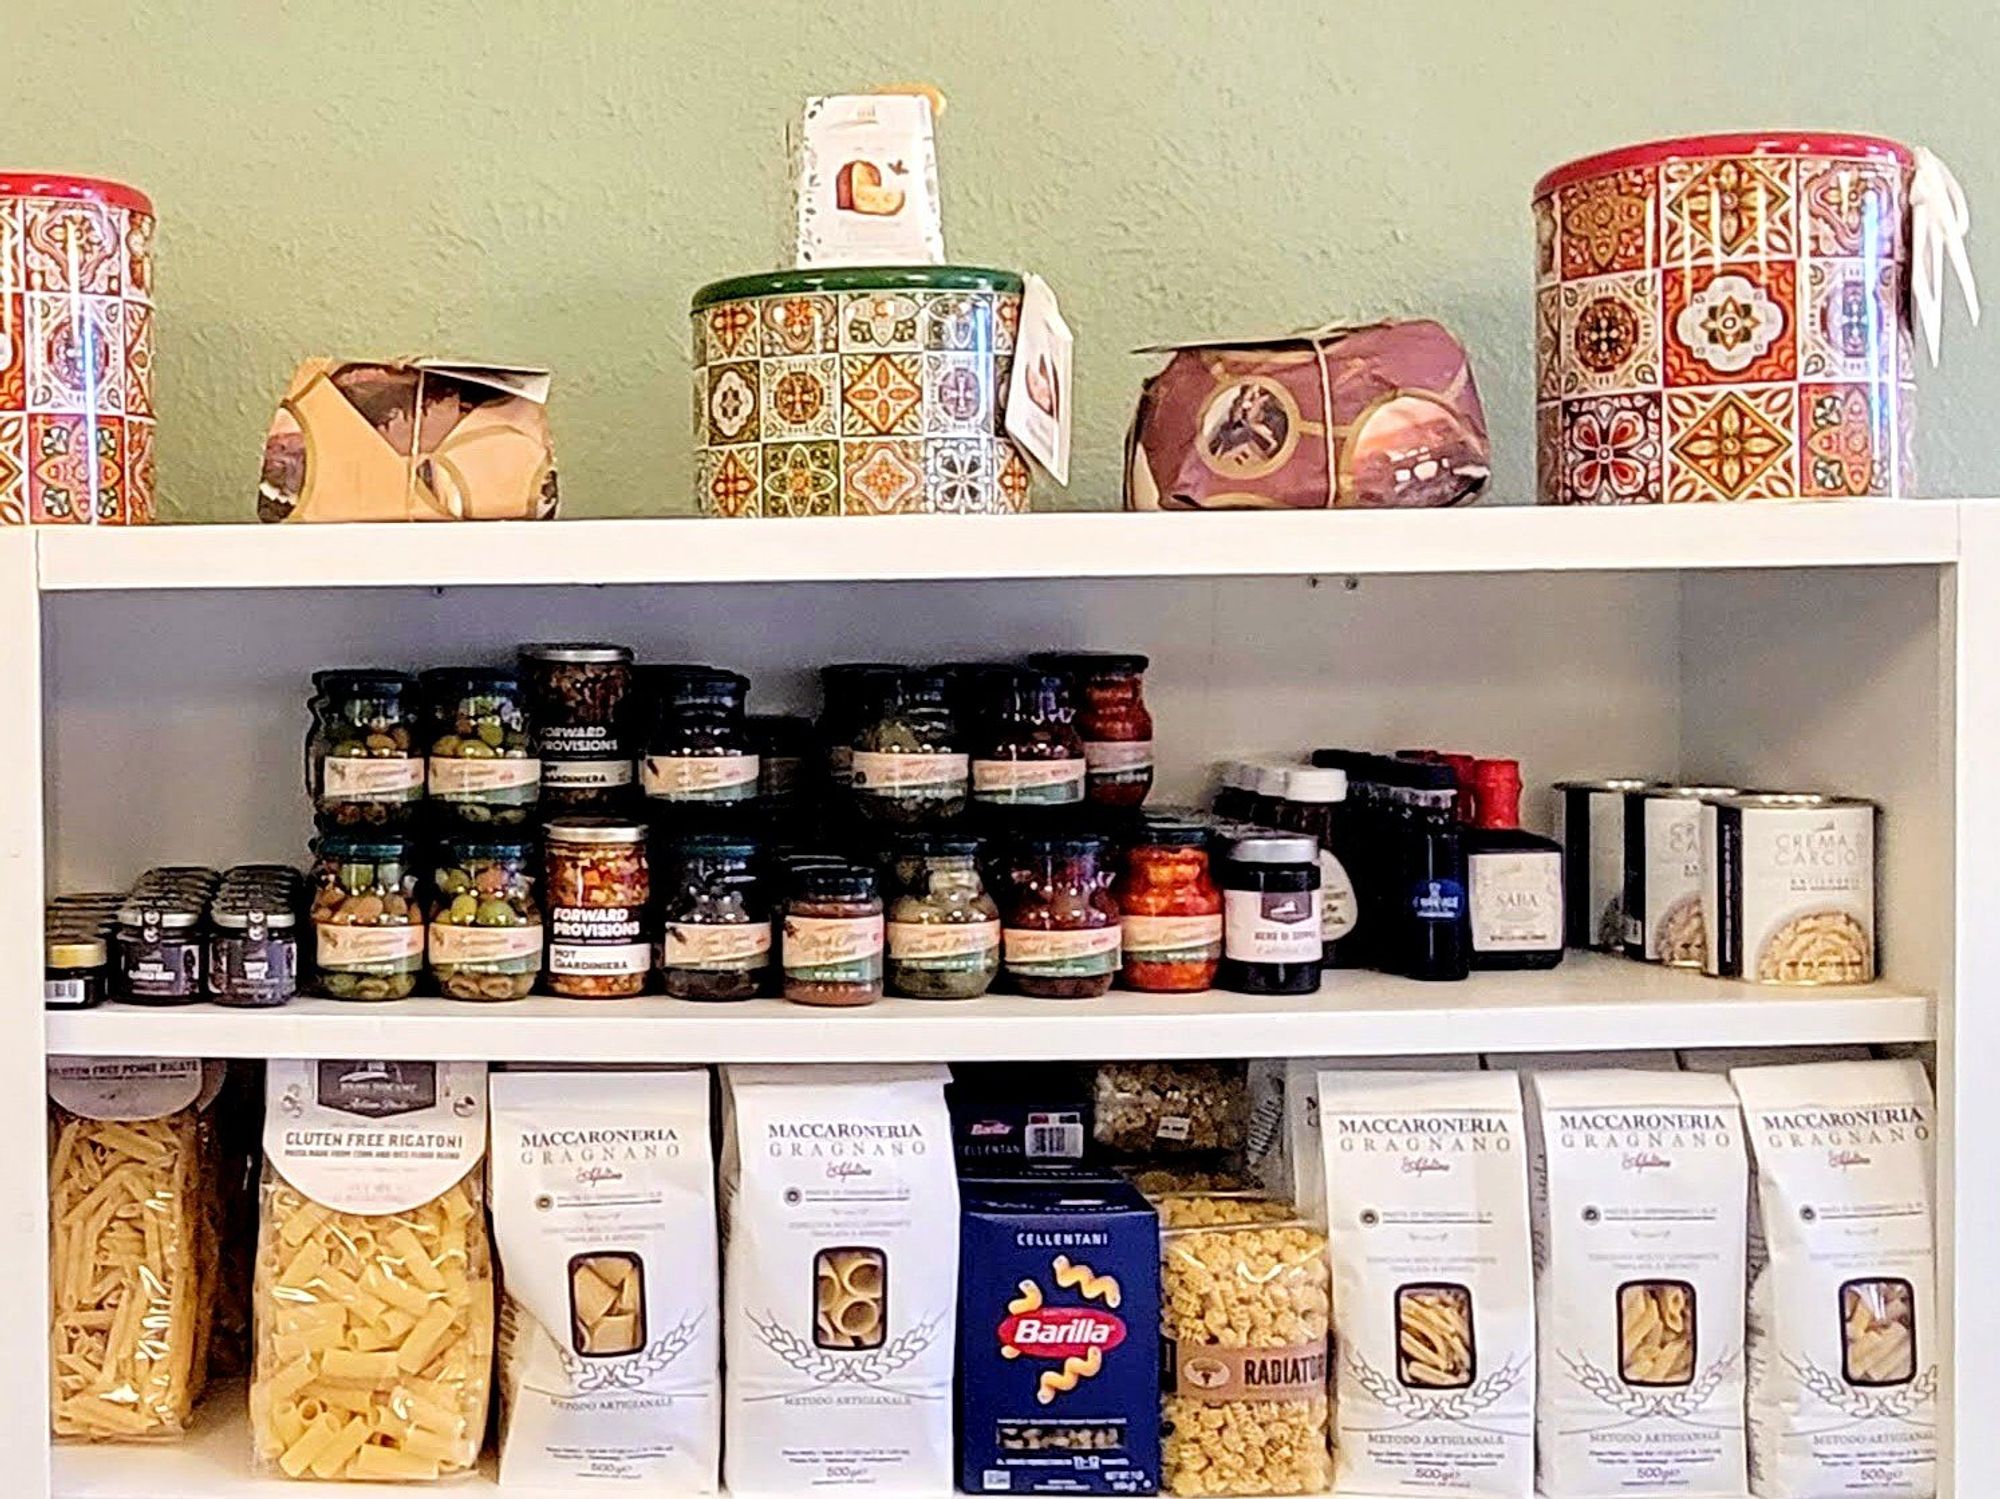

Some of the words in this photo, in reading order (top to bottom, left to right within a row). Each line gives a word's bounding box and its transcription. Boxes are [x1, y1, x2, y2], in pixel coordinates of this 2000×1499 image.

[553, 907, 629, 922] FORWARD
[553, 921, 640, 937] PROVISIONS
[1339, 1118, 1508, 1135] MACCARONERIA
[1560, 1113, 1727, 1131] MACCARONERIA
[1762, 1106, 1925, 1130] MACCARONERIA
[521, 1128, 679, 1148] MACCARONERIA
[768, 1123, 923, 1139] MACCARONERIA
[1768, 1124, 1930, 1148] GRAGNANO
[346, 1132, 385, 1148] FREE
[1340, 1136, 1511, 1152] GRAGNANO
[1561, 1132, 1731, 1149] GRAGNANO
[520, 1144, 680, 1165] GRAGNANO
[769, 1140, 926, 1158] GRAGNANO
[1016, 1231, 1109, 1247] CELLENTANI
[1013, 1318, 1110, 1344] Barilla
